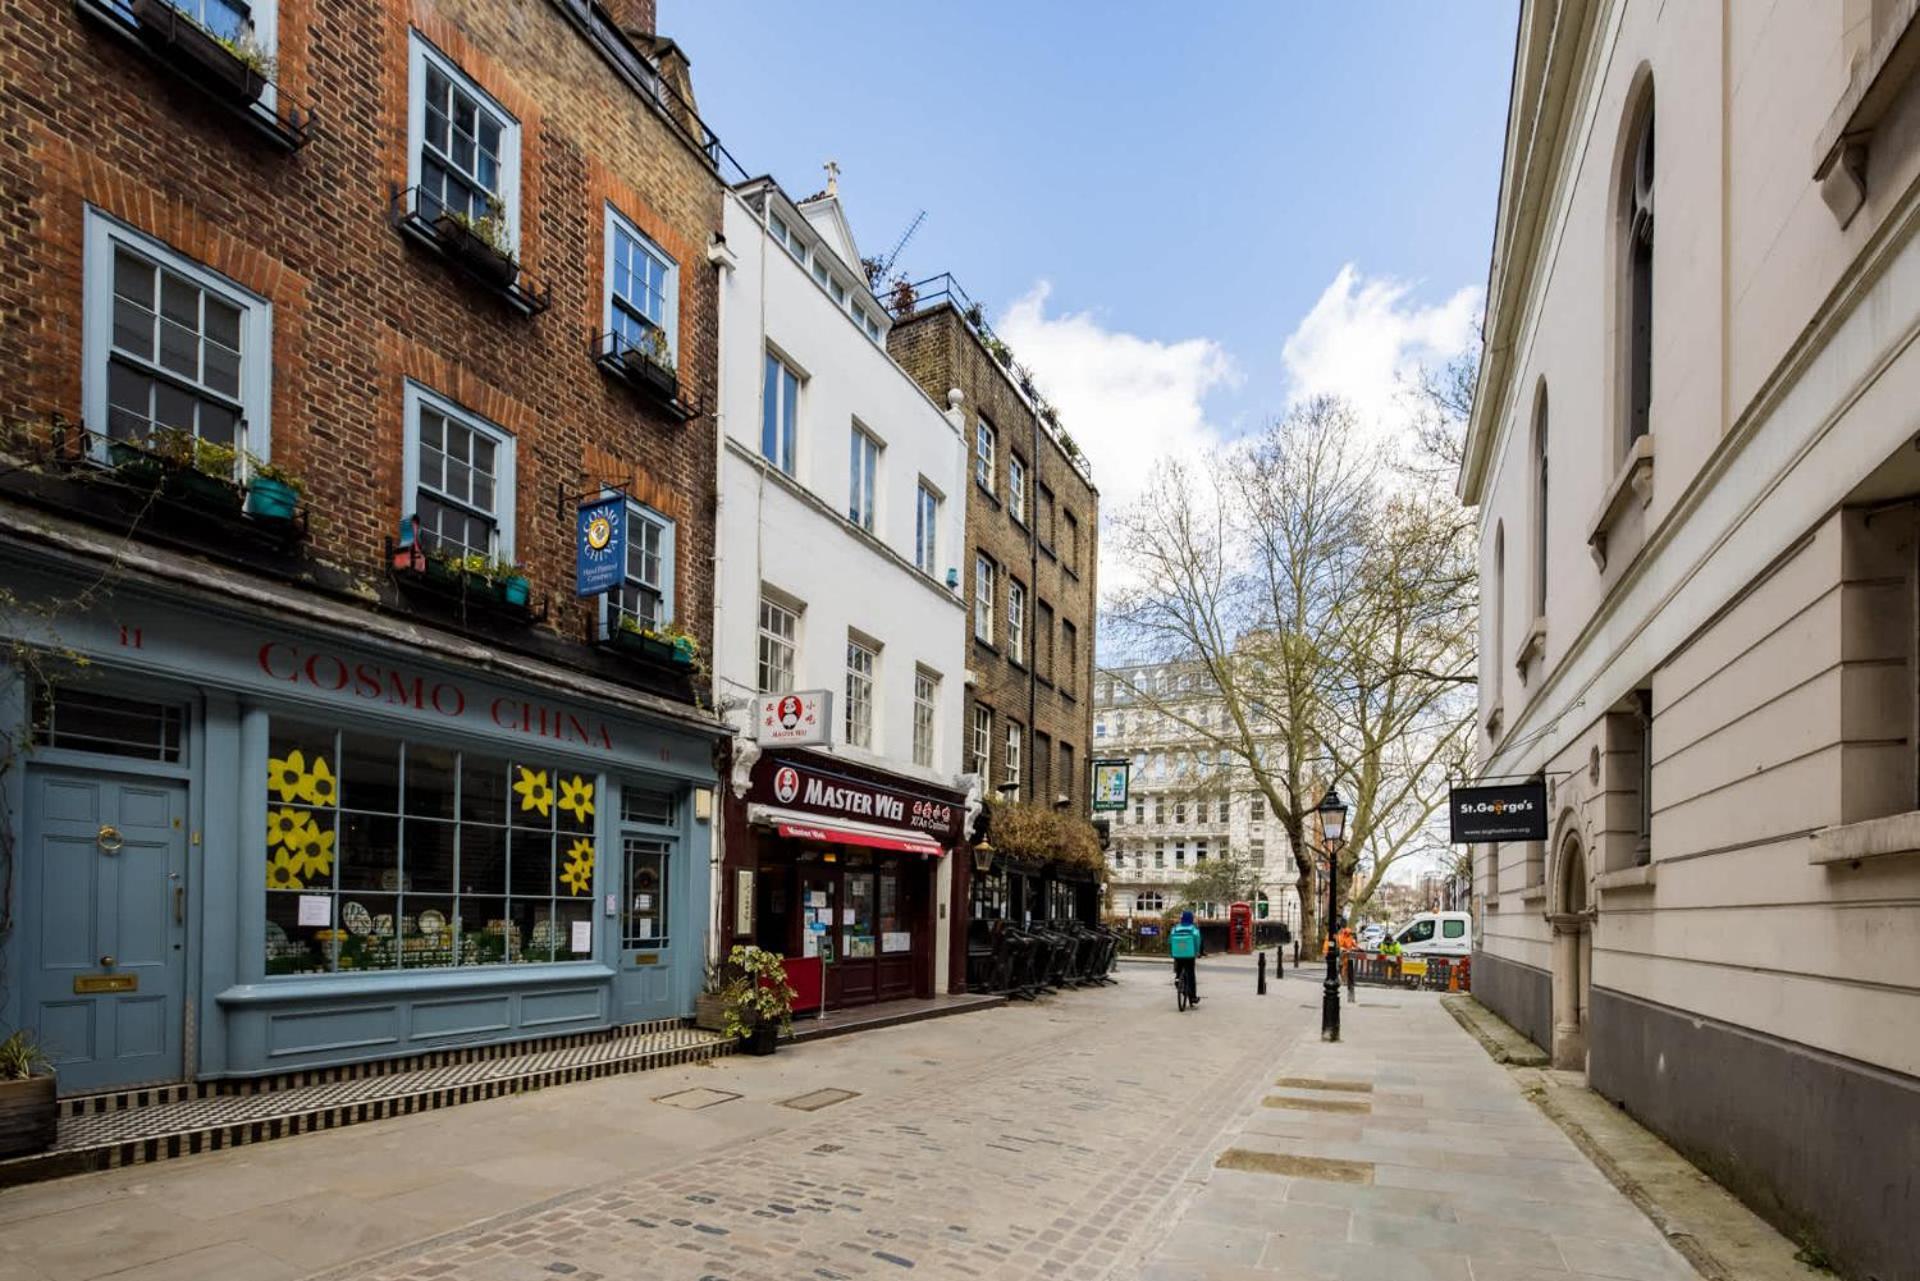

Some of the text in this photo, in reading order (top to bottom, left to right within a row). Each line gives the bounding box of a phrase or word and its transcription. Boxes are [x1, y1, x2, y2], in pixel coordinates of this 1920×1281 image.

[583, 506, 619, 530] COSMO
[584, 540, 618, 561] CHINA
[259, 641, 613, 750] COSMO CHINA
